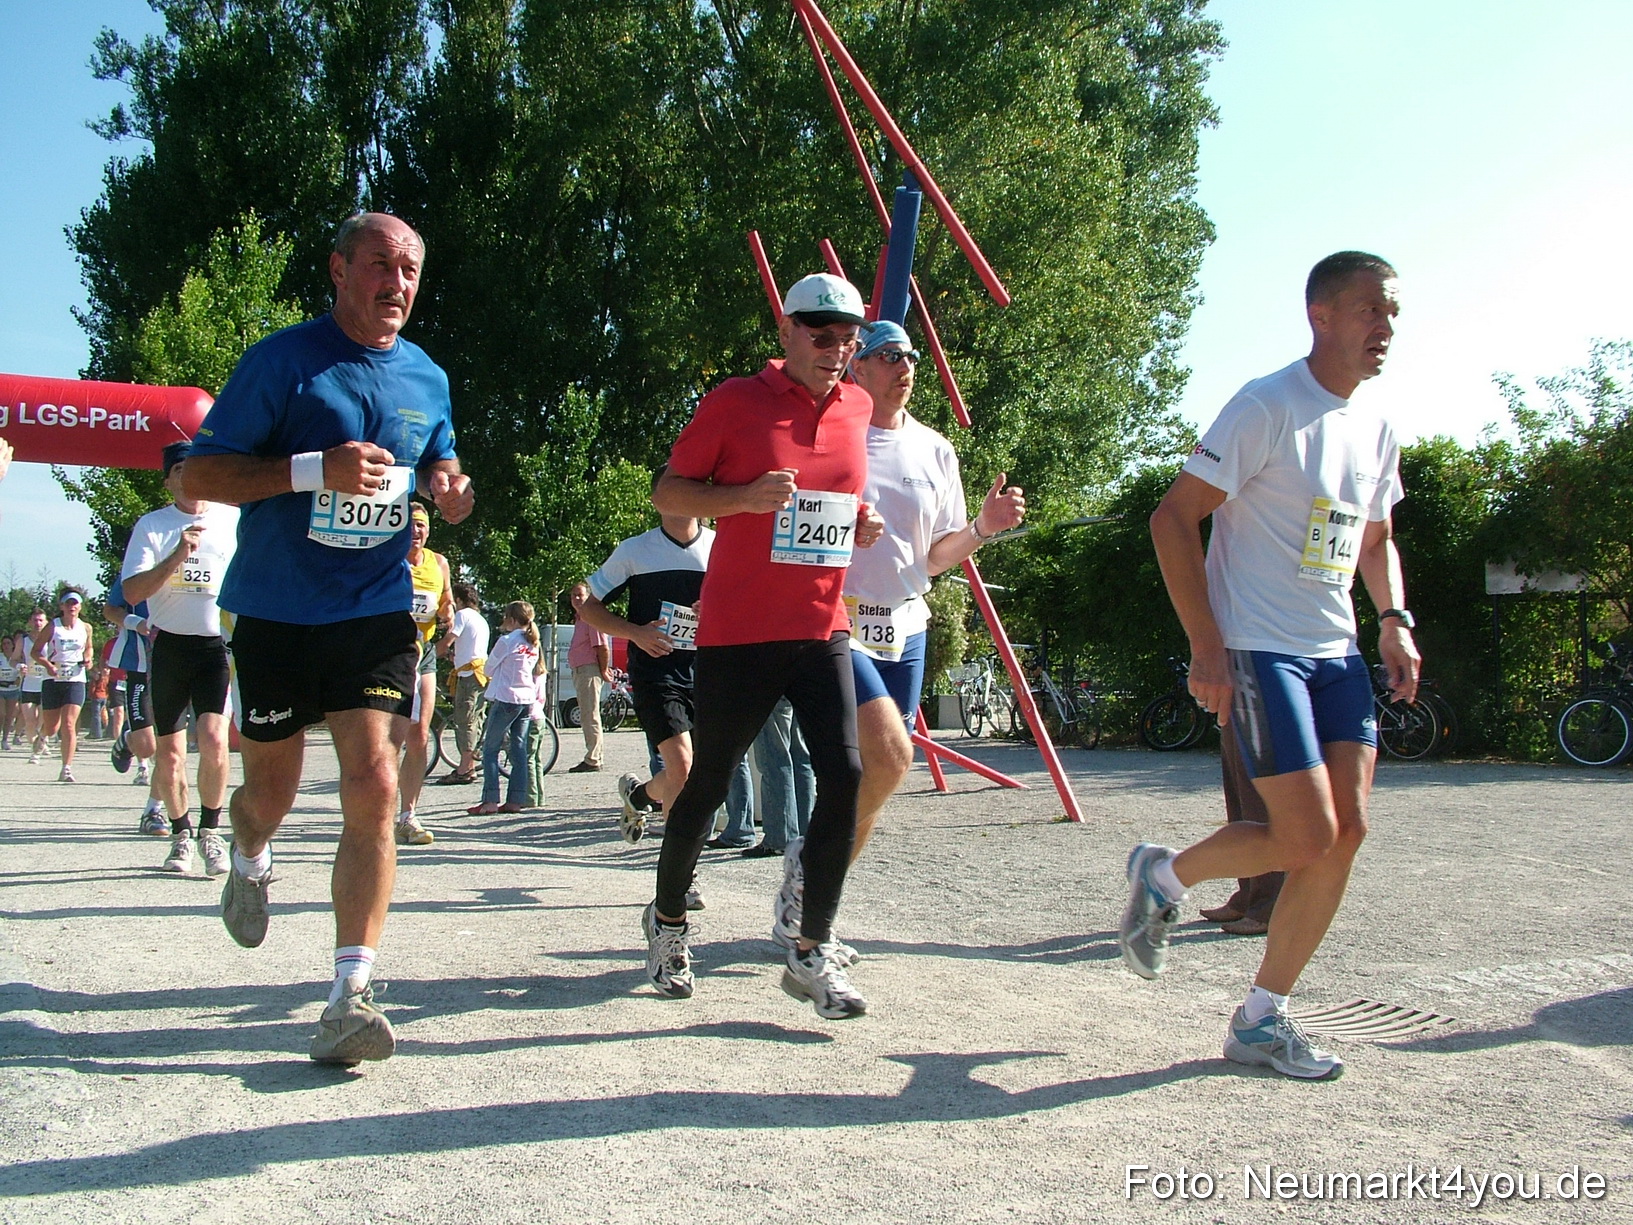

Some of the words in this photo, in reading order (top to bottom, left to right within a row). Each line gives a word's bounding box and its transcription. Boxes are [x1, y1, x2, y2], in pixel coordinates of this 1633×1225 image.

[19, 402, 150, 432] LGS-Park
[318, 493, 330, 507] C
[798, 498, 822, 513] Karl
[339, 501, 402, 527] 3075
[780, 516, 790, 529] C
[797, 522, 850, 546] 2407
[1312, 528, 1320, 541] B
[1328, 536, 1352, 562] 144
[184, 569, 211, 583] 325
[858, 604, 892, 617] Stefan
[861, 624, 895, 644] 138
[363, 686, 402, 699] adidas
[131, 683, 145, 721] Sinupret
